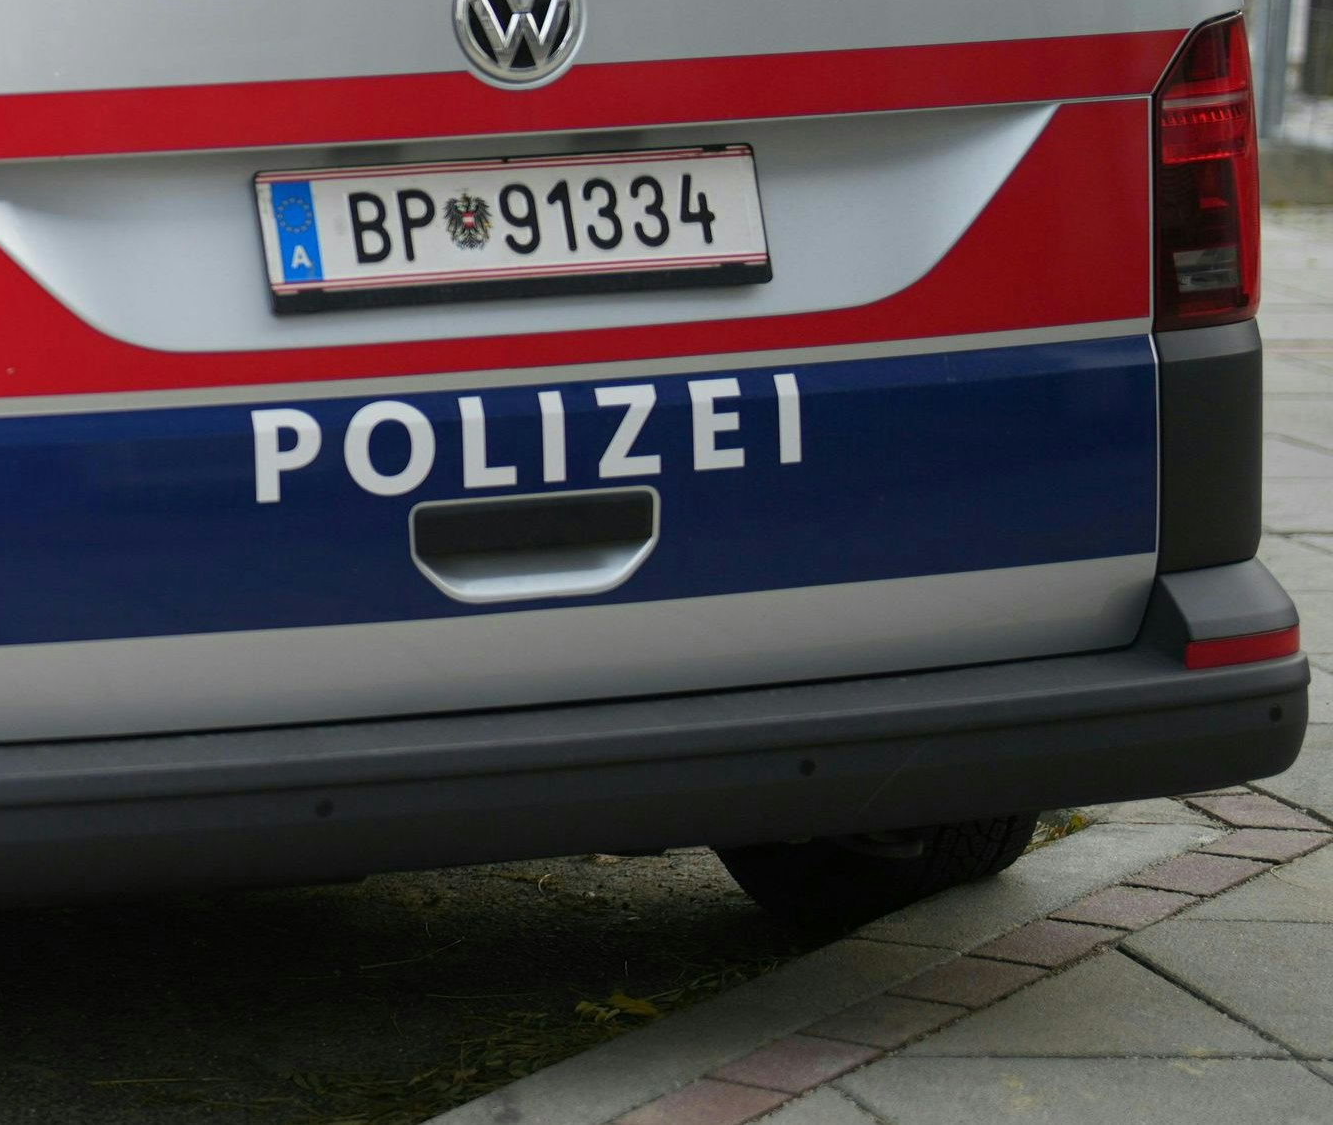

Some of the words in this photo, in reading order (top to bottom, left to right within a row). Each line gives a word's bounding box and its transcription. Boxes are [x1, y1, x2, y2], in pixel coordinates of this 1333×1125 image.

[290, 244, 313, 270] A
[348, 188, 435, 264] BP
[499, 173, 716, 255] 91334
[250, 373, 803, 504] POLIZEI
